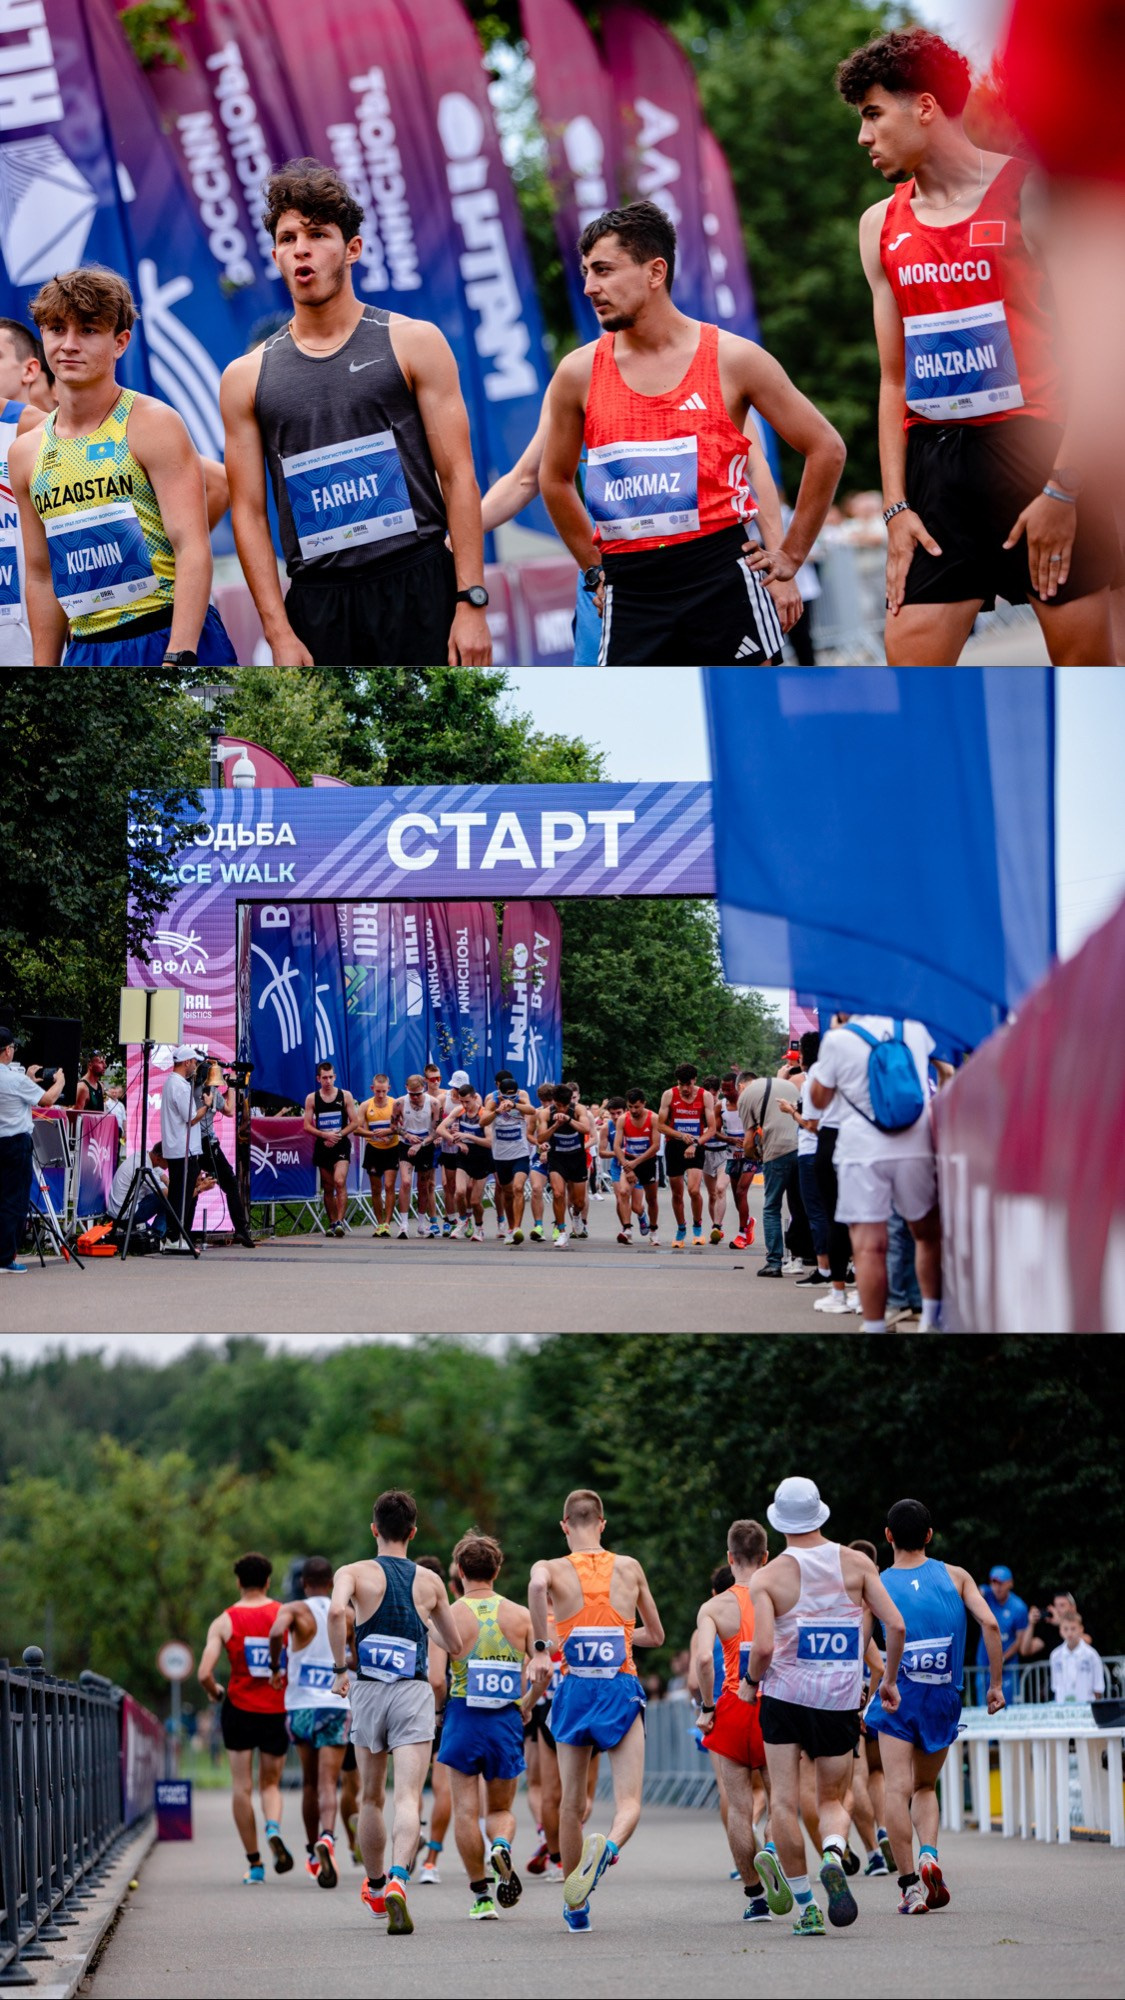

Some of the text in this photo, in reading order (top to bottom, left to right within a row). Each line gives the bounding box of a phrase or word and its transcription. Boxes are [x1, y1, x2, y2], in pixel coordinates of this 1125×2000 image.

[897, 259, 991, 287] MOROCCO
[914, 344, 998, 379] GHAZRANI
[34, 475, 134, 514] QAZAQSTAN
[311, 473, 379, 512] FARHAT
[604, 472, 681, 502] KORKMAZ
[66, 541, 123, 575] KUZMIN
[386, 810, 635, 871] СТАРТ
[220, 862, 297, 884] WALK
[185, 994, 212, 1010] RAL
[276, 1150, 300, 1165] ВФЛА
[574, 1641, 615, 1662] 176
[807, 1632, 848, 1654] 170
[368, 1647, 406, 1669] 175
[911, 1651, 948, 1671] 168
[475, 1673, 514, 1694] 180
